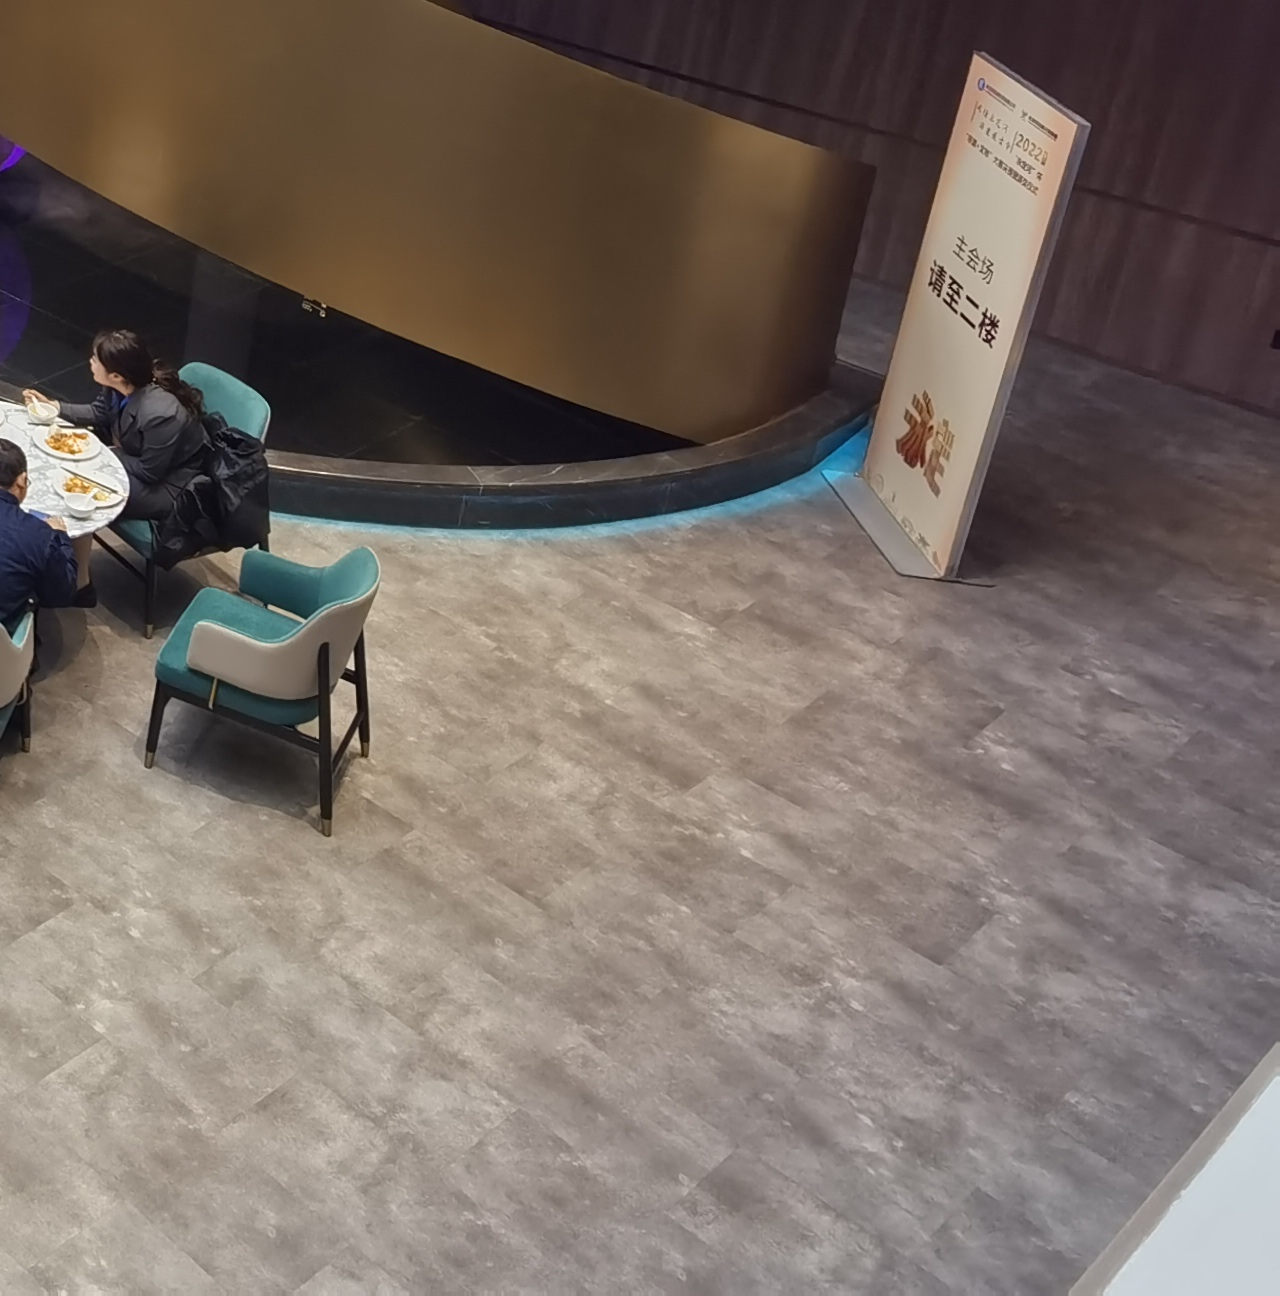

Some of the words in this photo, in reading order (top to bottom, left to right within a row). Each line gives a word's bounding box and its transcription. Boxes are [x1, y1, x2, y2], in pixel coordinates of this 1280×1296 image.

[1015, 133, 1042, 163] 2022
[952, 235, 995, 285] 主会场
[928, 259, 1000, 349] 请至二楼
